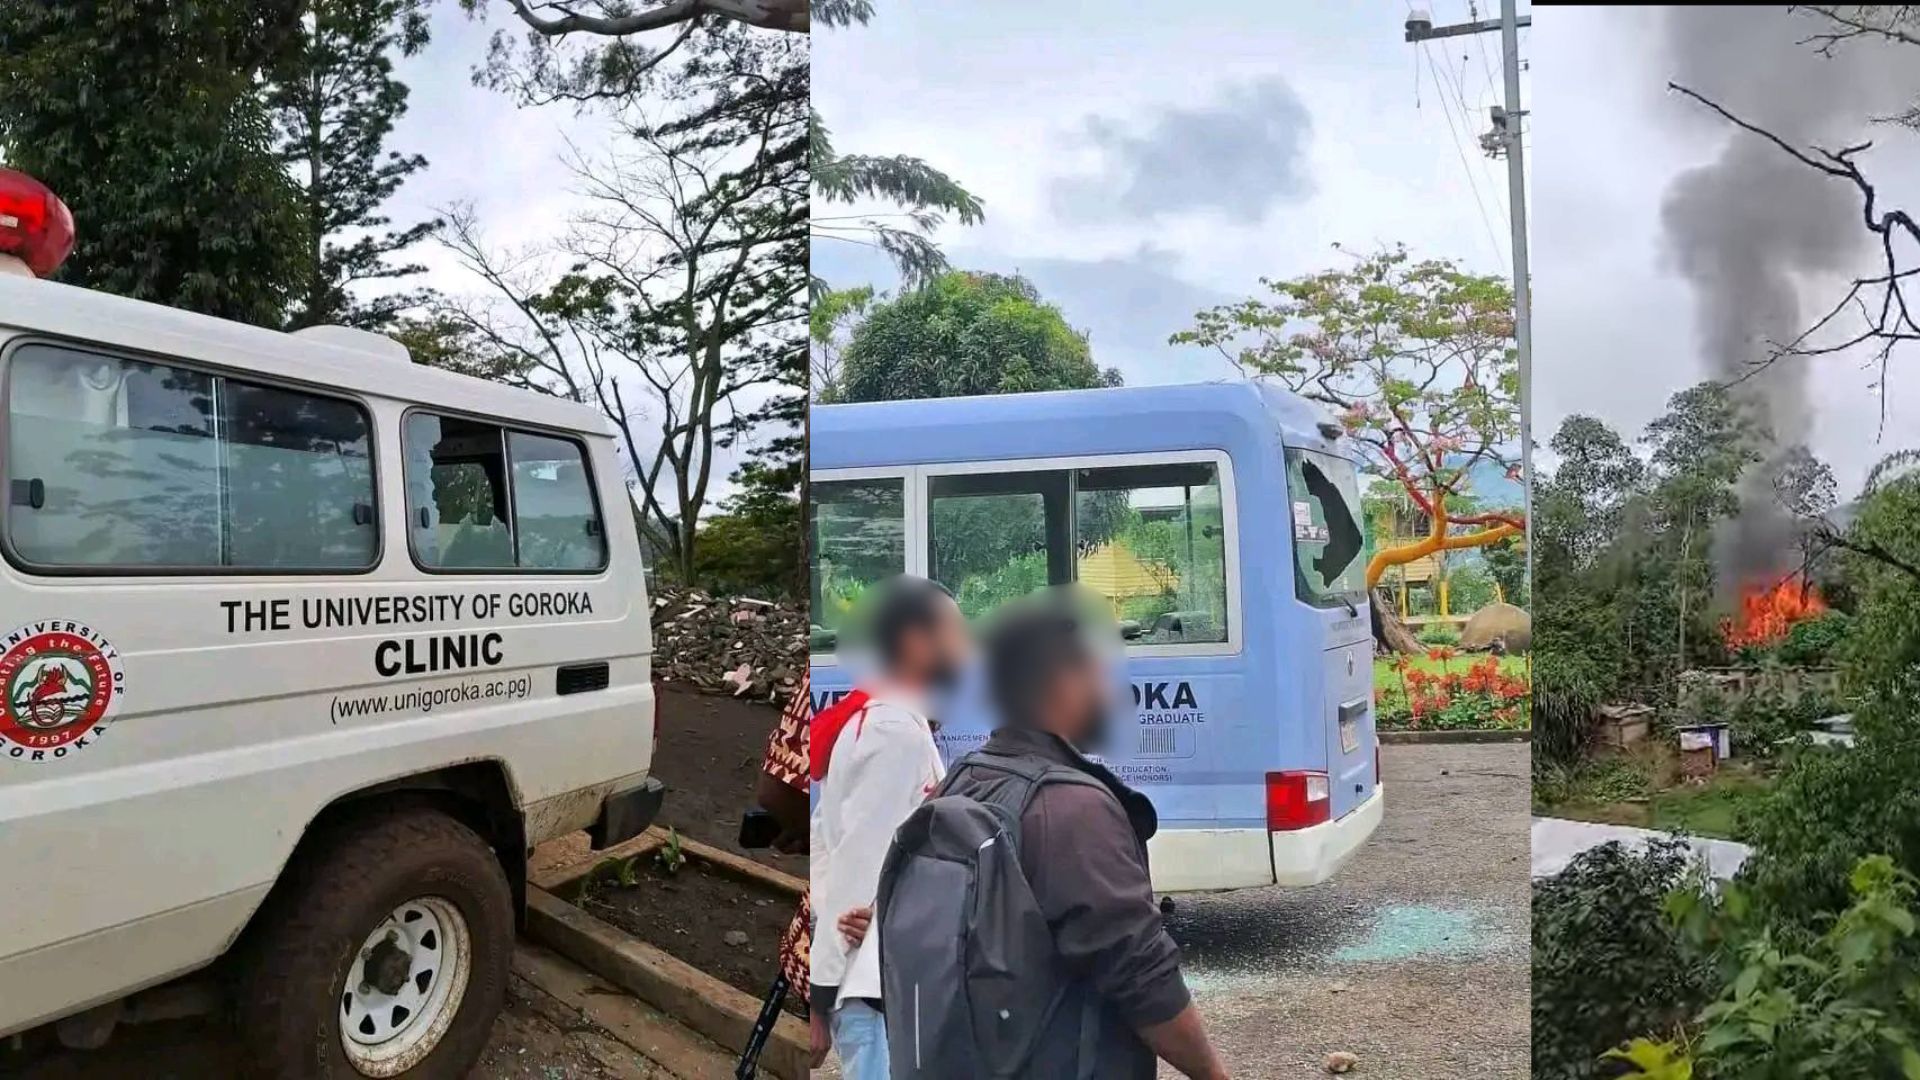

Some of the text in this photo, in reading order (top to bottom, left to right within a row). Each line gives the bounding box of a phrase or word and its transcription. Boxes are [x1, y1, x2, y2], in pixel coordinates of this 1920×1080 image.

[220, 591, 593, 633] THE UNIVERSITY OF GOROKA
[375, 632, 504, 677] CLINIC
[0, 645, 36, 717] Cating
[48, 639, 82, 651] the
[114, 671, 124, 694] OF
[331, 673, 532, 724] (www.unigoroka.ac.pg)
[28, 731, 71, 744] 1997
